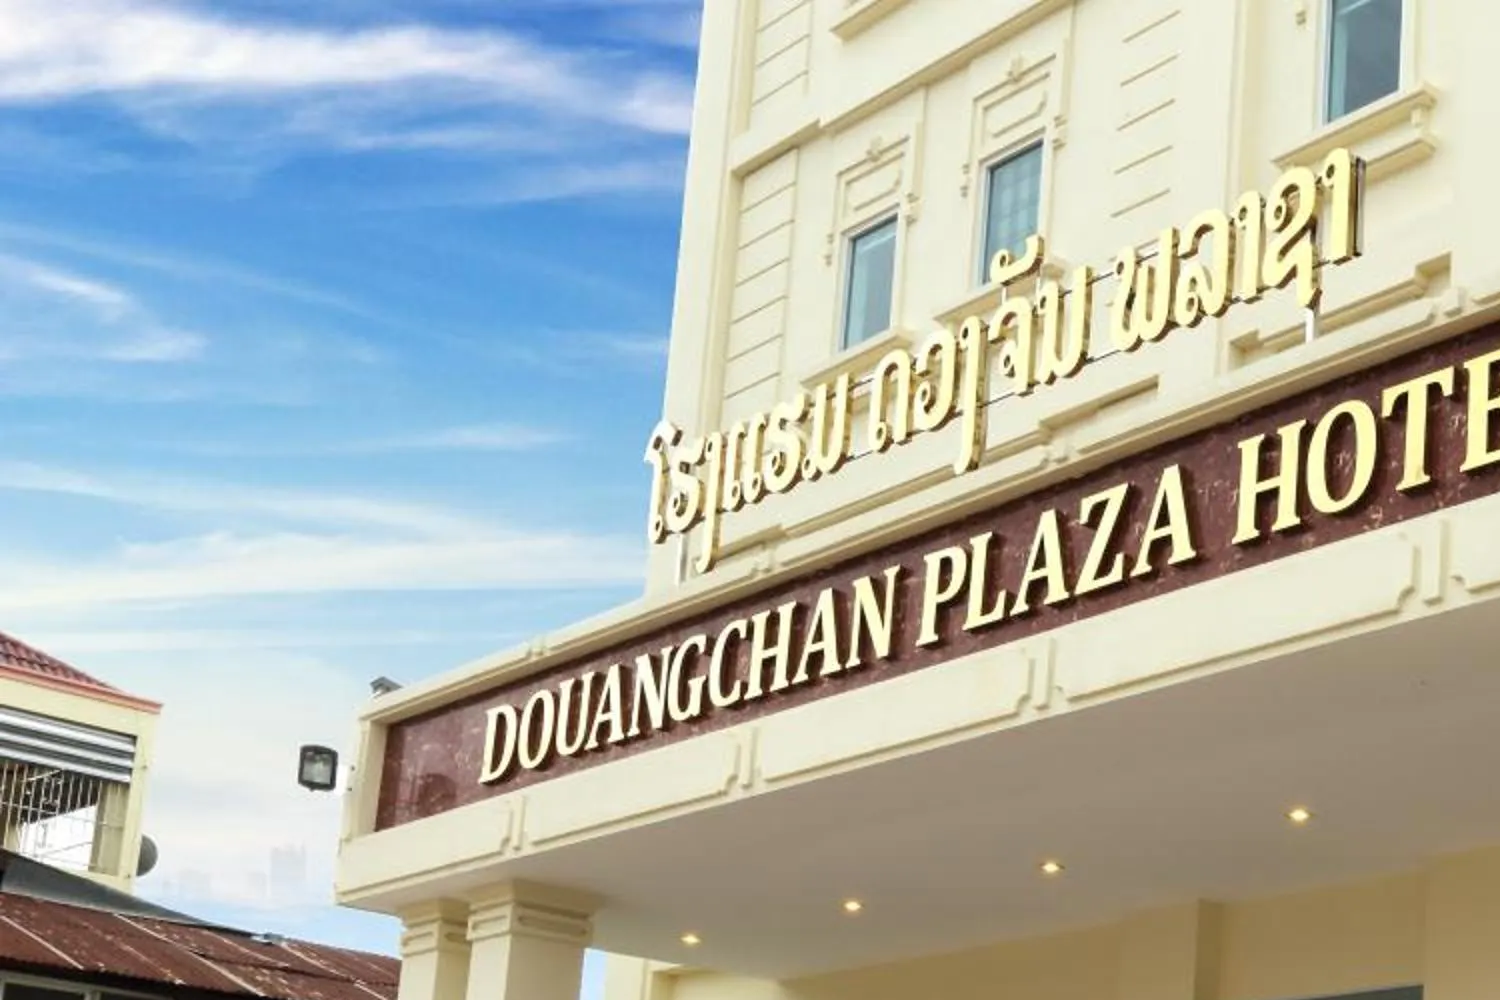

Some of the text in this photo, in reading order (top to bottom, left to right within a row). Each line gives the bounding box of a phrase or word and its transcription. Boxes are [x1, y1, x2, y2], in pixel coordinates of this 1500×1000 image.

[644, 372, 852, 574] ໂຮງແຮມ
[868, 234, 1092, 475] ດວງຈັນ
[479, 564, 901, 784] DOUANGCHAN
[915, 475, 1197, 646] PLAZA
